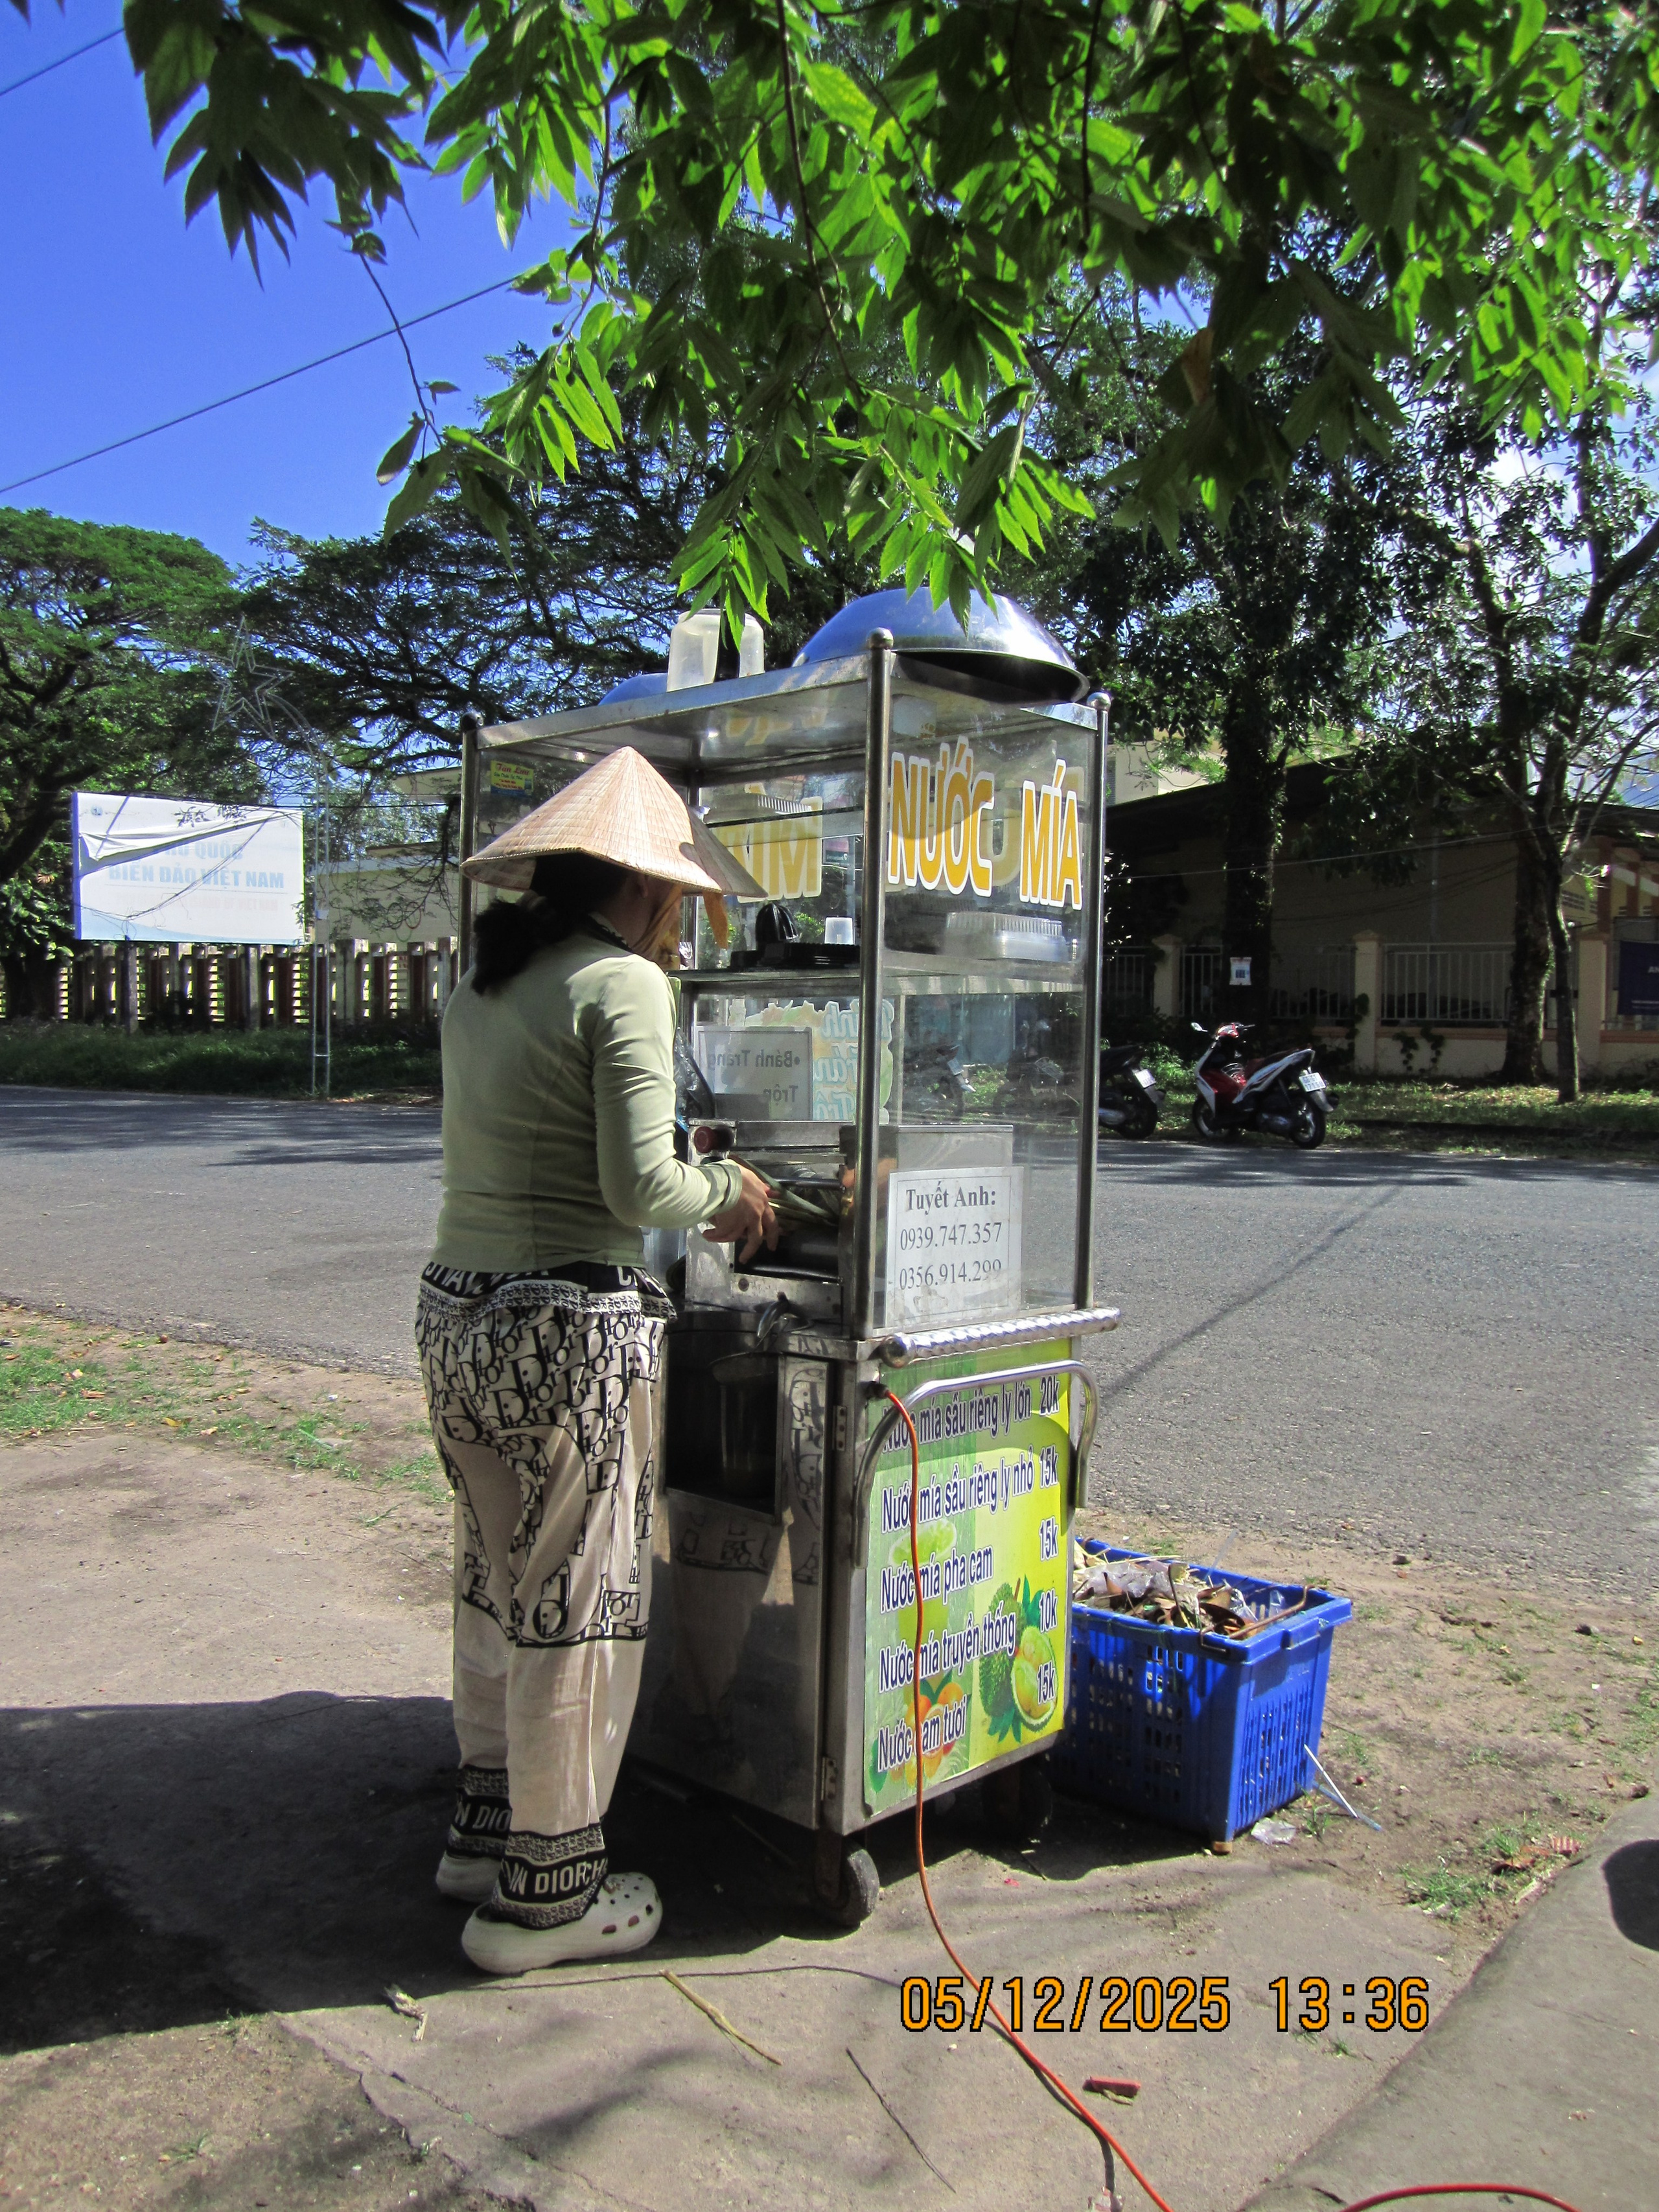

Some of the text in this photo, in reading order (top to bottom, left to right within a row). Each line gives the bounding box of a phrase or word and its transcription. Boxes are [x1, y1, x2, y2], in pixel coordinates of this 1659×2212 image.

[888, 735, 1083, 911] NƯỚC MÍA
[246, 870, 284, 889] NAM
[899, 1222, 1002, 1251] 0939.747.357
[906, 1180, 996, 1215] Tuyết Anh:
[919, 1396, 942, 1445] mía
[969, 1388, 999, 1439] riêng
[1001, 1382, 1012, 1436] ly
[1039, 1375, 1060, 1416] 20k
[919, 1473, 942, 1524] mía
[945, 1463, 967, 1517] sầu
[969, 1461, 999, 1515] riêng
[1000, 1457, 1012, 1511] ly
[1012, 1445, 1035, 1497] nhỏ
[1039, 1445, 1059, 1489] 15k
[880, 1515, 1059, 1614] Nước mía pha cam 15k
[878, 1588, 1058, 1694] Nước mía truyền thống 10k
[877, 1660, 1056, 1773] Nước am tươi 15k
